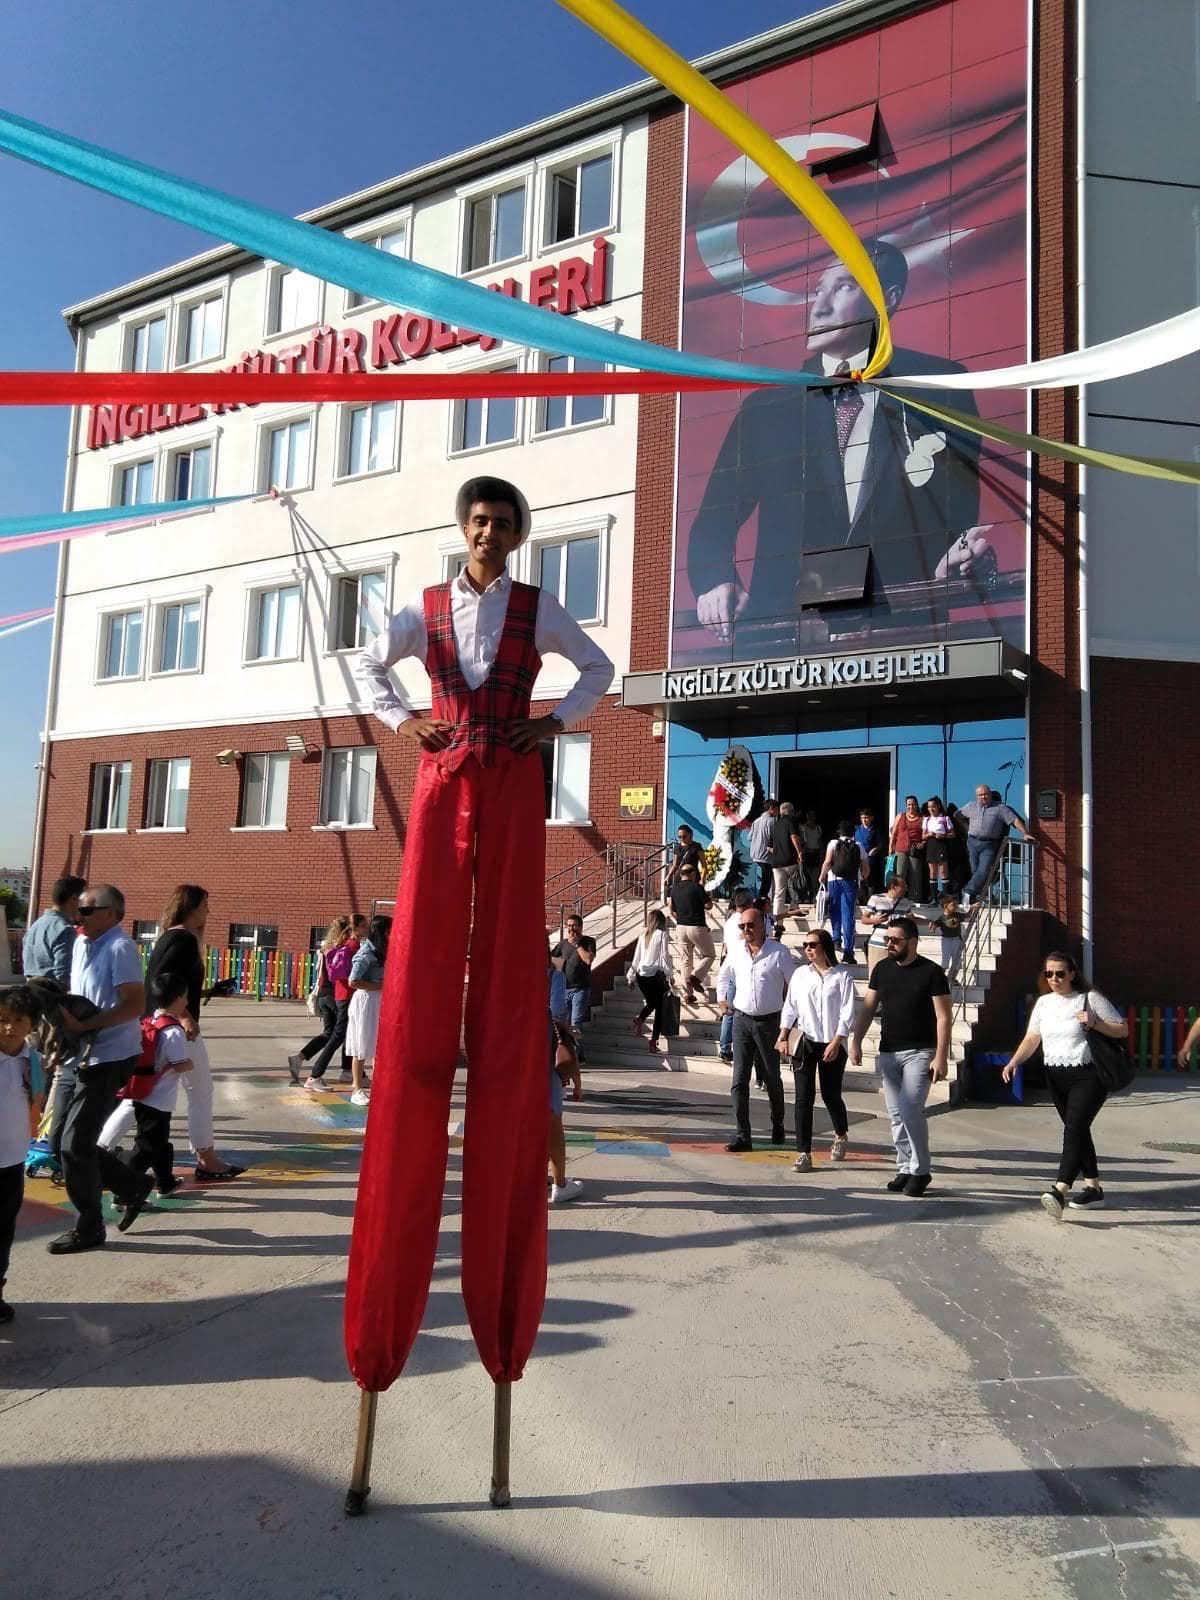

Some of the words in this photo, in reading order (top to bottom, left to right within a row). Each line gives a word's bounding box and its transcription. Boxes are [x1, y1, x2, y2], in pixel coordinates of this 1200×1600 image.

[373, 236, 607, 369] KOLERİ
[661, 665, 735, 698] İNGİLİZ
[738, 658, 823, 690] KÜLTÜR
[828, 645, 947, 685] KOLEJLERİ
